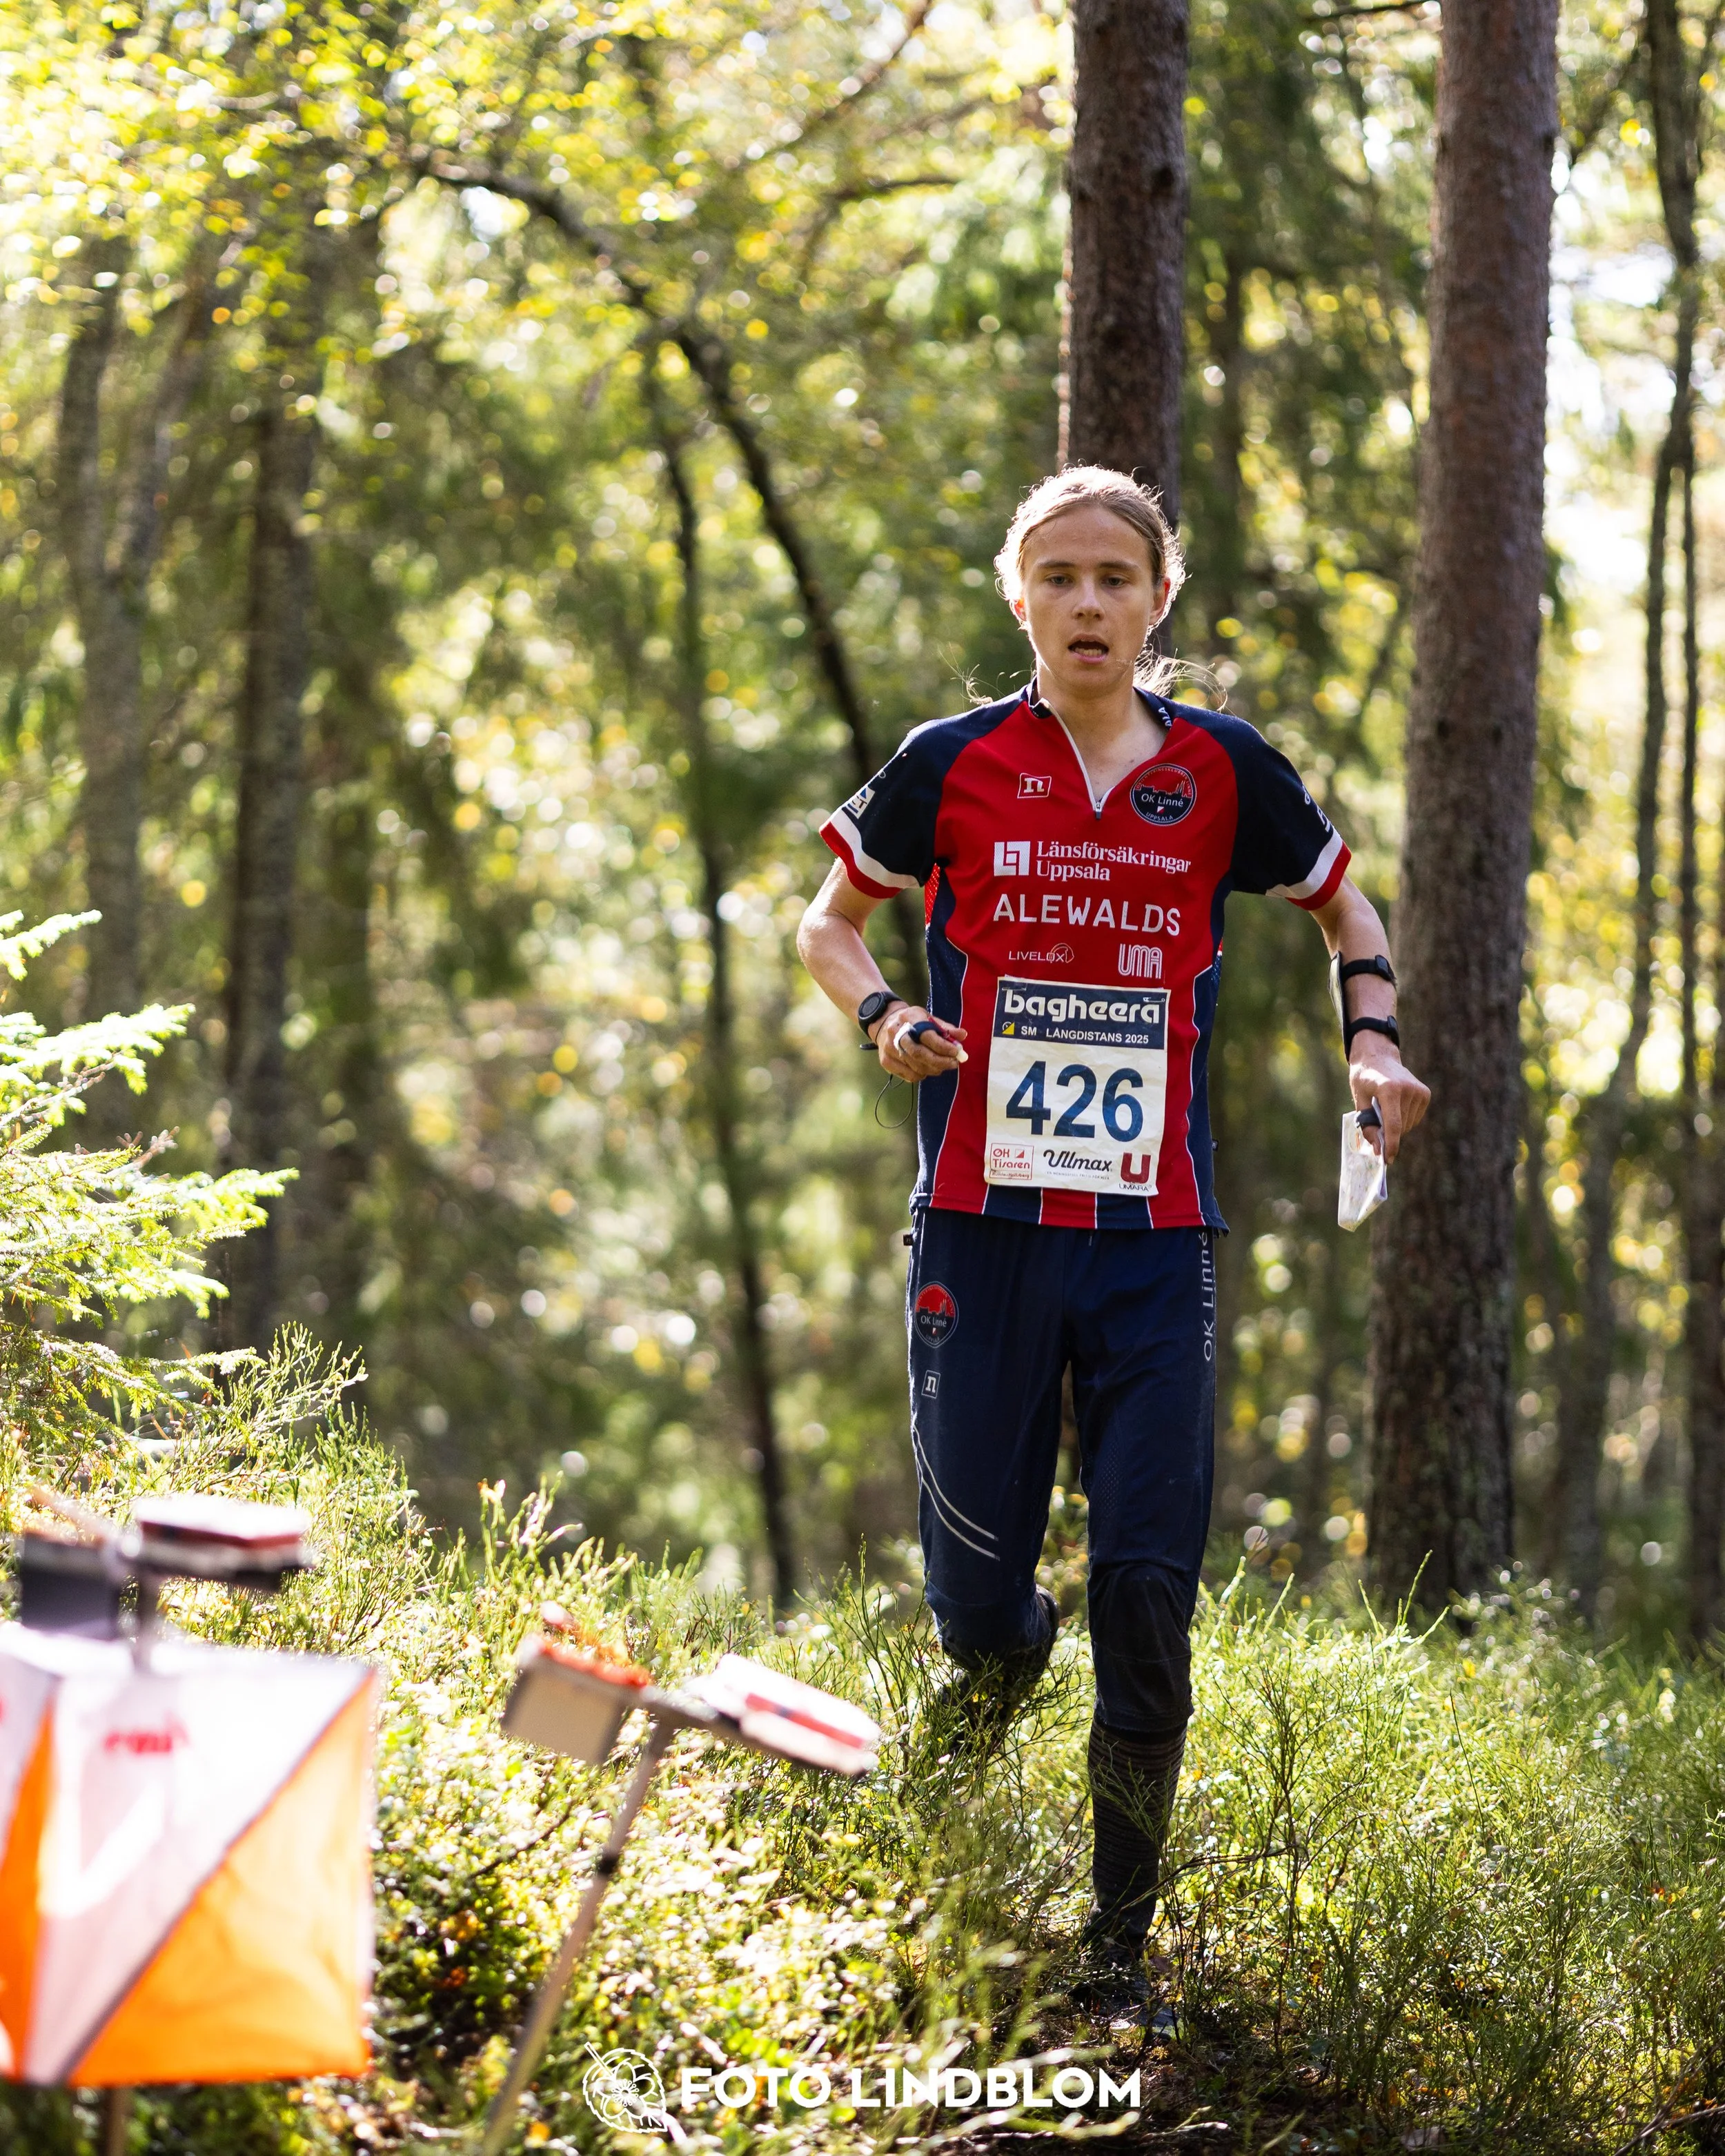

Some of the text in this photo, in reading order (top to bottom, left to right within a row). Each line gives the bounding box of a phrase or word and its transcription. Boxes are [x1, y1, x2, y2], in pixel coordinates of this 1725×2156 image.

[1141, 793, 1184, 807] OK Linné
[1145, 812, 1174, 822] UPPSALA
[1036, 840, 1192, 874] Länsförsäkringar
[1036, 860, 1111, 882] Uppsala
[993, 893, 1181, 936] ALEWALDS
[1008, 950, 1065, 963] LIVELOX
[1118, 943, 1163, 979] UMA
[1004, 989, 1160, 1024] bagheera
[1021, 1026, 1037, 1036] SM
[1125, 1034, 1149, 1044] 2025
[1006, 1060, 1144, 1143] 426
[1043, 1149, 1112, 1172] Ullmax
[1199, 1232, 1214, 1361] OK Linné
[921, 1315, 931, 1325] OK
